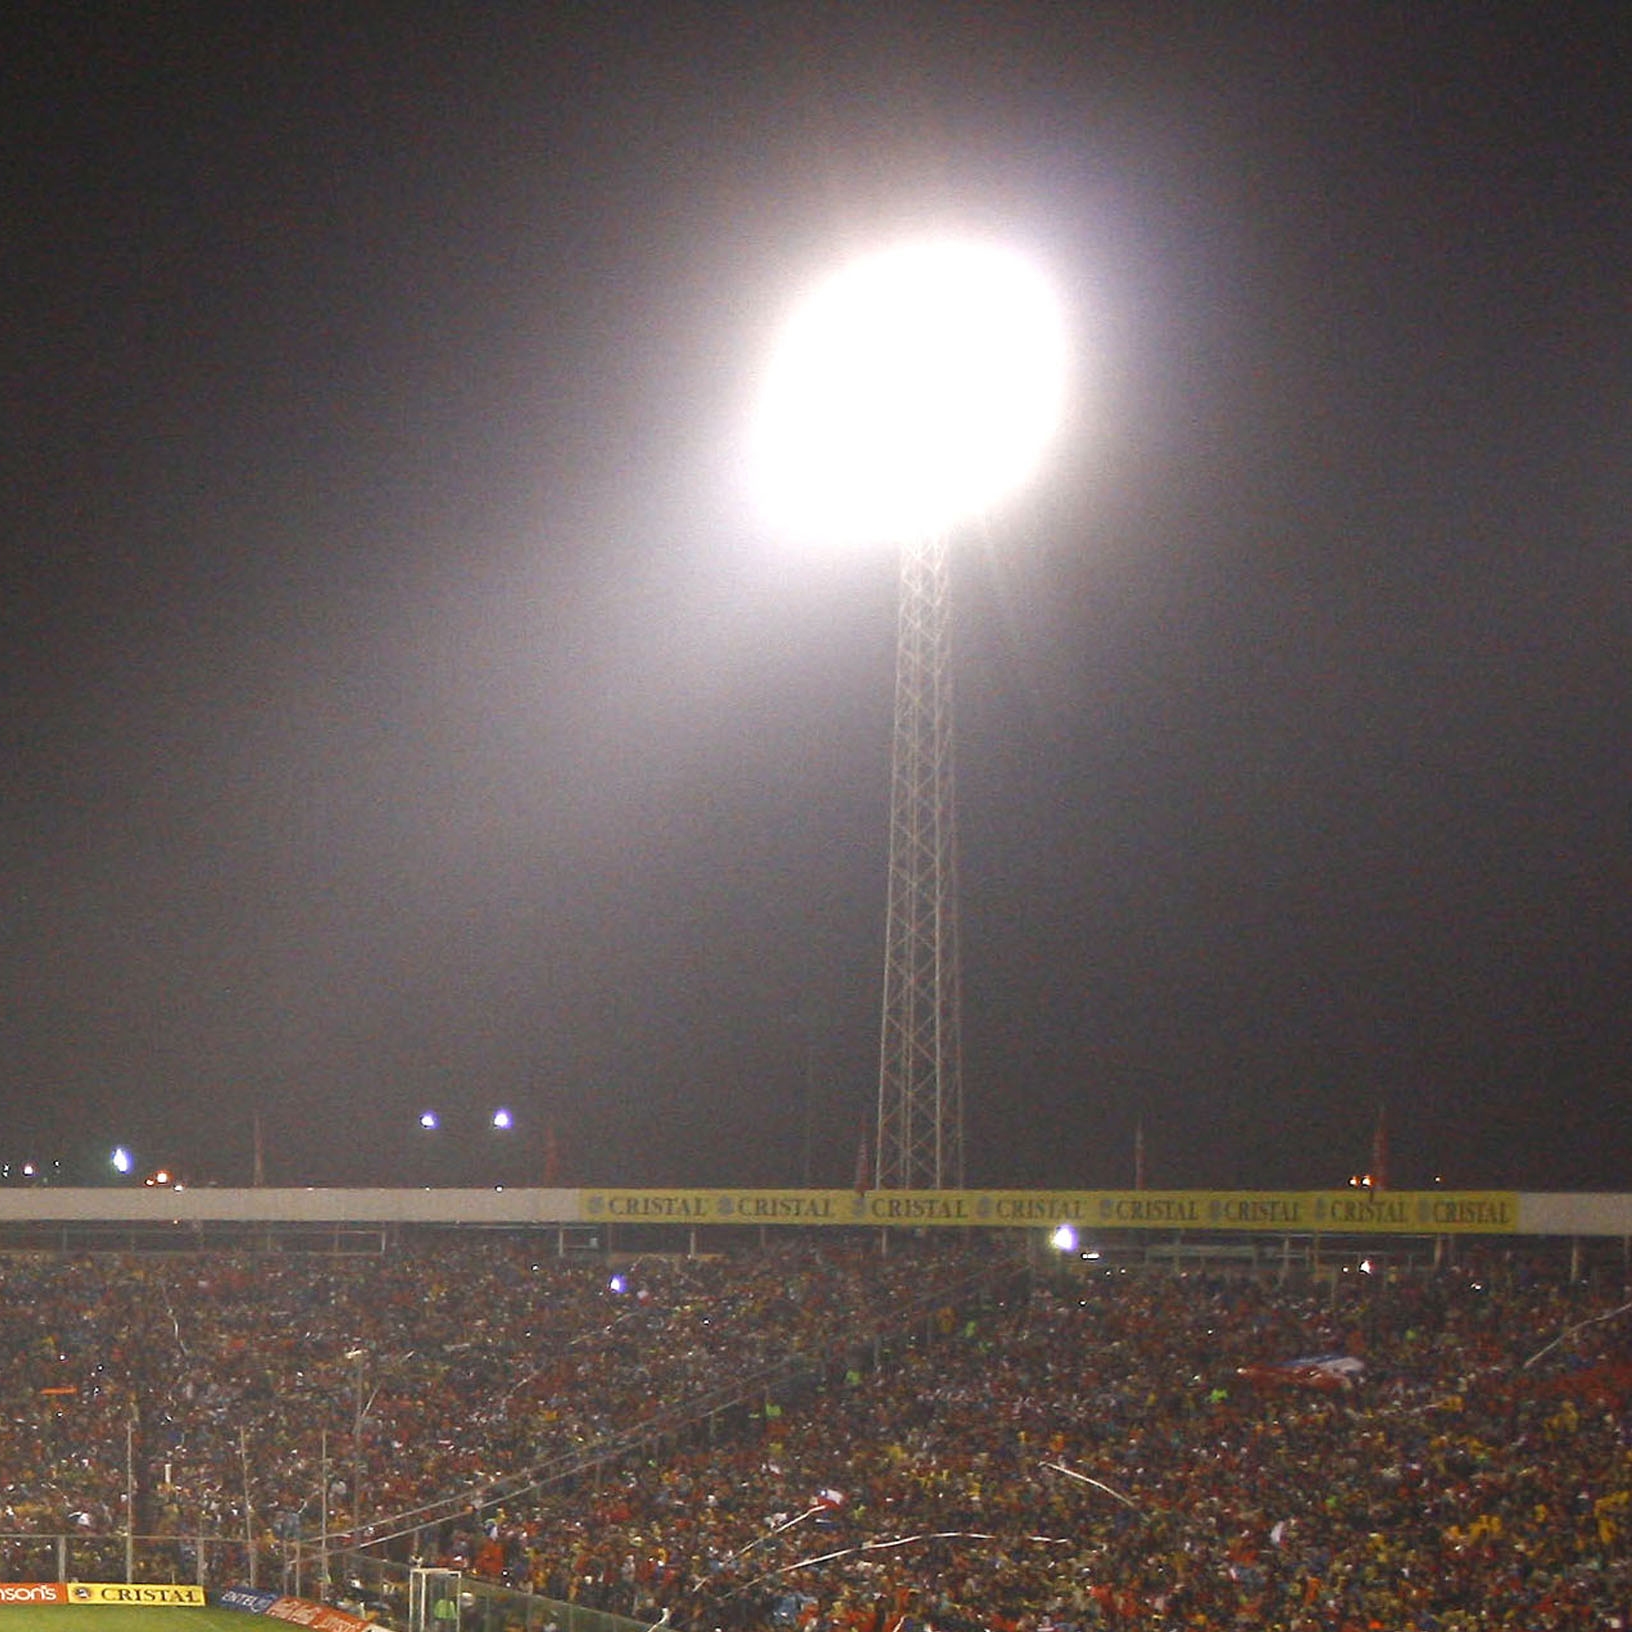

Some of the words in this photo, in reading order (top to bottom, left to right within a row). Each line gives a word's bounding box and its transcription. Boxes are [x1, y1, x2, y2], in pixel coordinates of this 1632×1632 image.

[609, 1197, 707, 1216] CRISTAL
[738, 1197, 834, 1217] CRISTAL
[871, 1198, 968, 1218] CRISTAL
[996, 1199, 1085, 1219] CRISTAL
[1116, 1199, 1198, 1221] CRISTAL
[1224, 1200, 1300, 1222] CRISTAL
[1331, 1200, 1409, 1223] CRISTAL
[1433, 1200, 1510, 1224] CRISTAL
